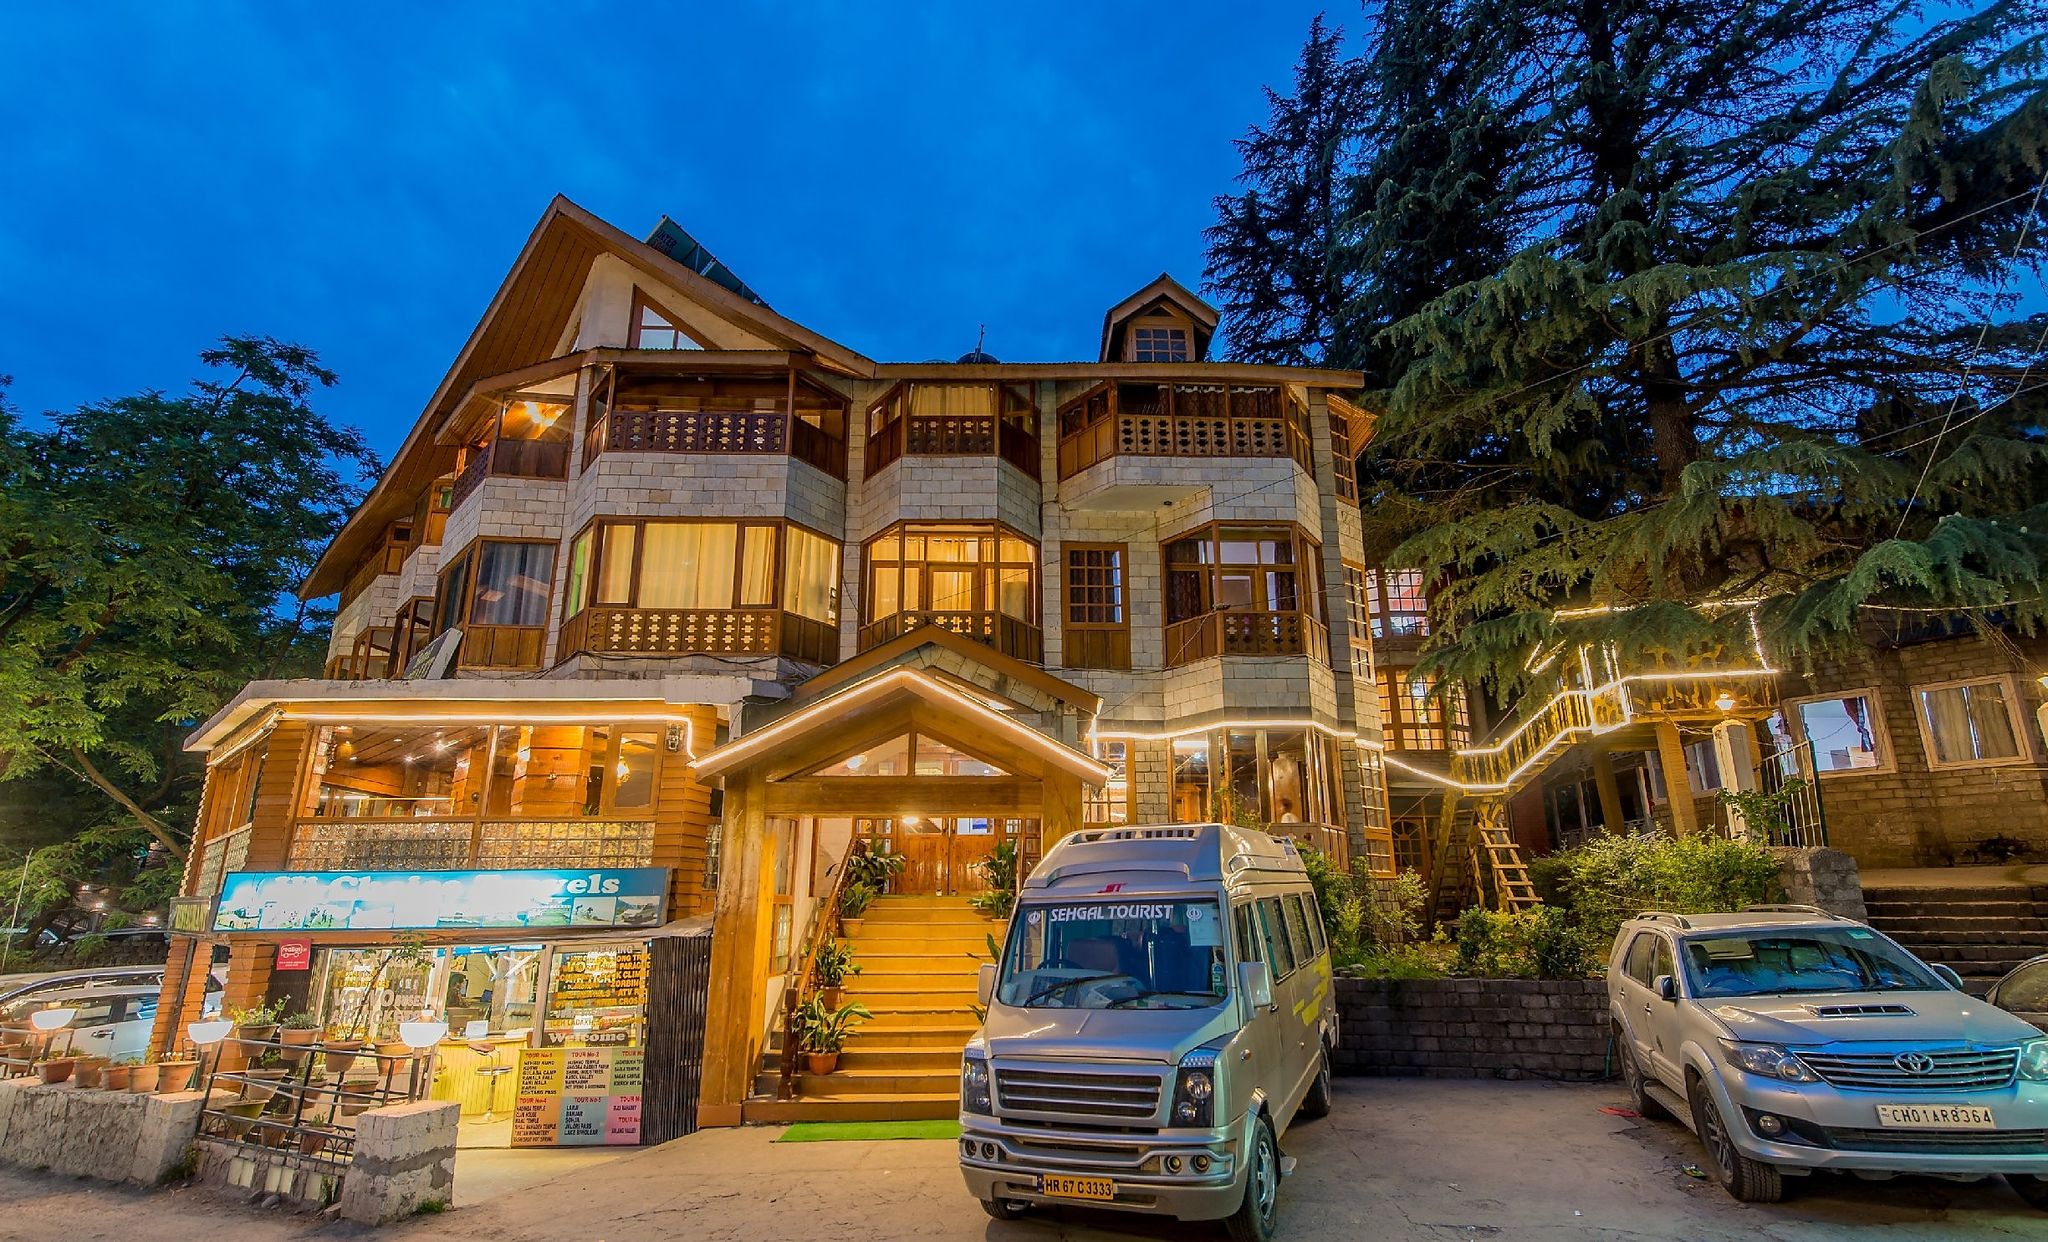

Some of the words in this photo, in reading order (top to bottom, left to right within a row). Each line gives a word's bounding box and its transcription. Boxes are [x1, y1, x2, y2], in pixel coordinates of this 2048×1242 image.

[1051, 905, 1104, 922] SEHGAL
[1108, 904, 1173, 920] TOURIST
[549, 1032, 625, 1043] Welcome
[1893, 1109, 1991, 1123] CH01AR8364
[1046, 1179, 1060, 1192] HR
[1063, 1181, 1074, 1193] 67
[1078, 1182, 1084, 1193] C
[1086, 1182, 1111, 1196] 3333
